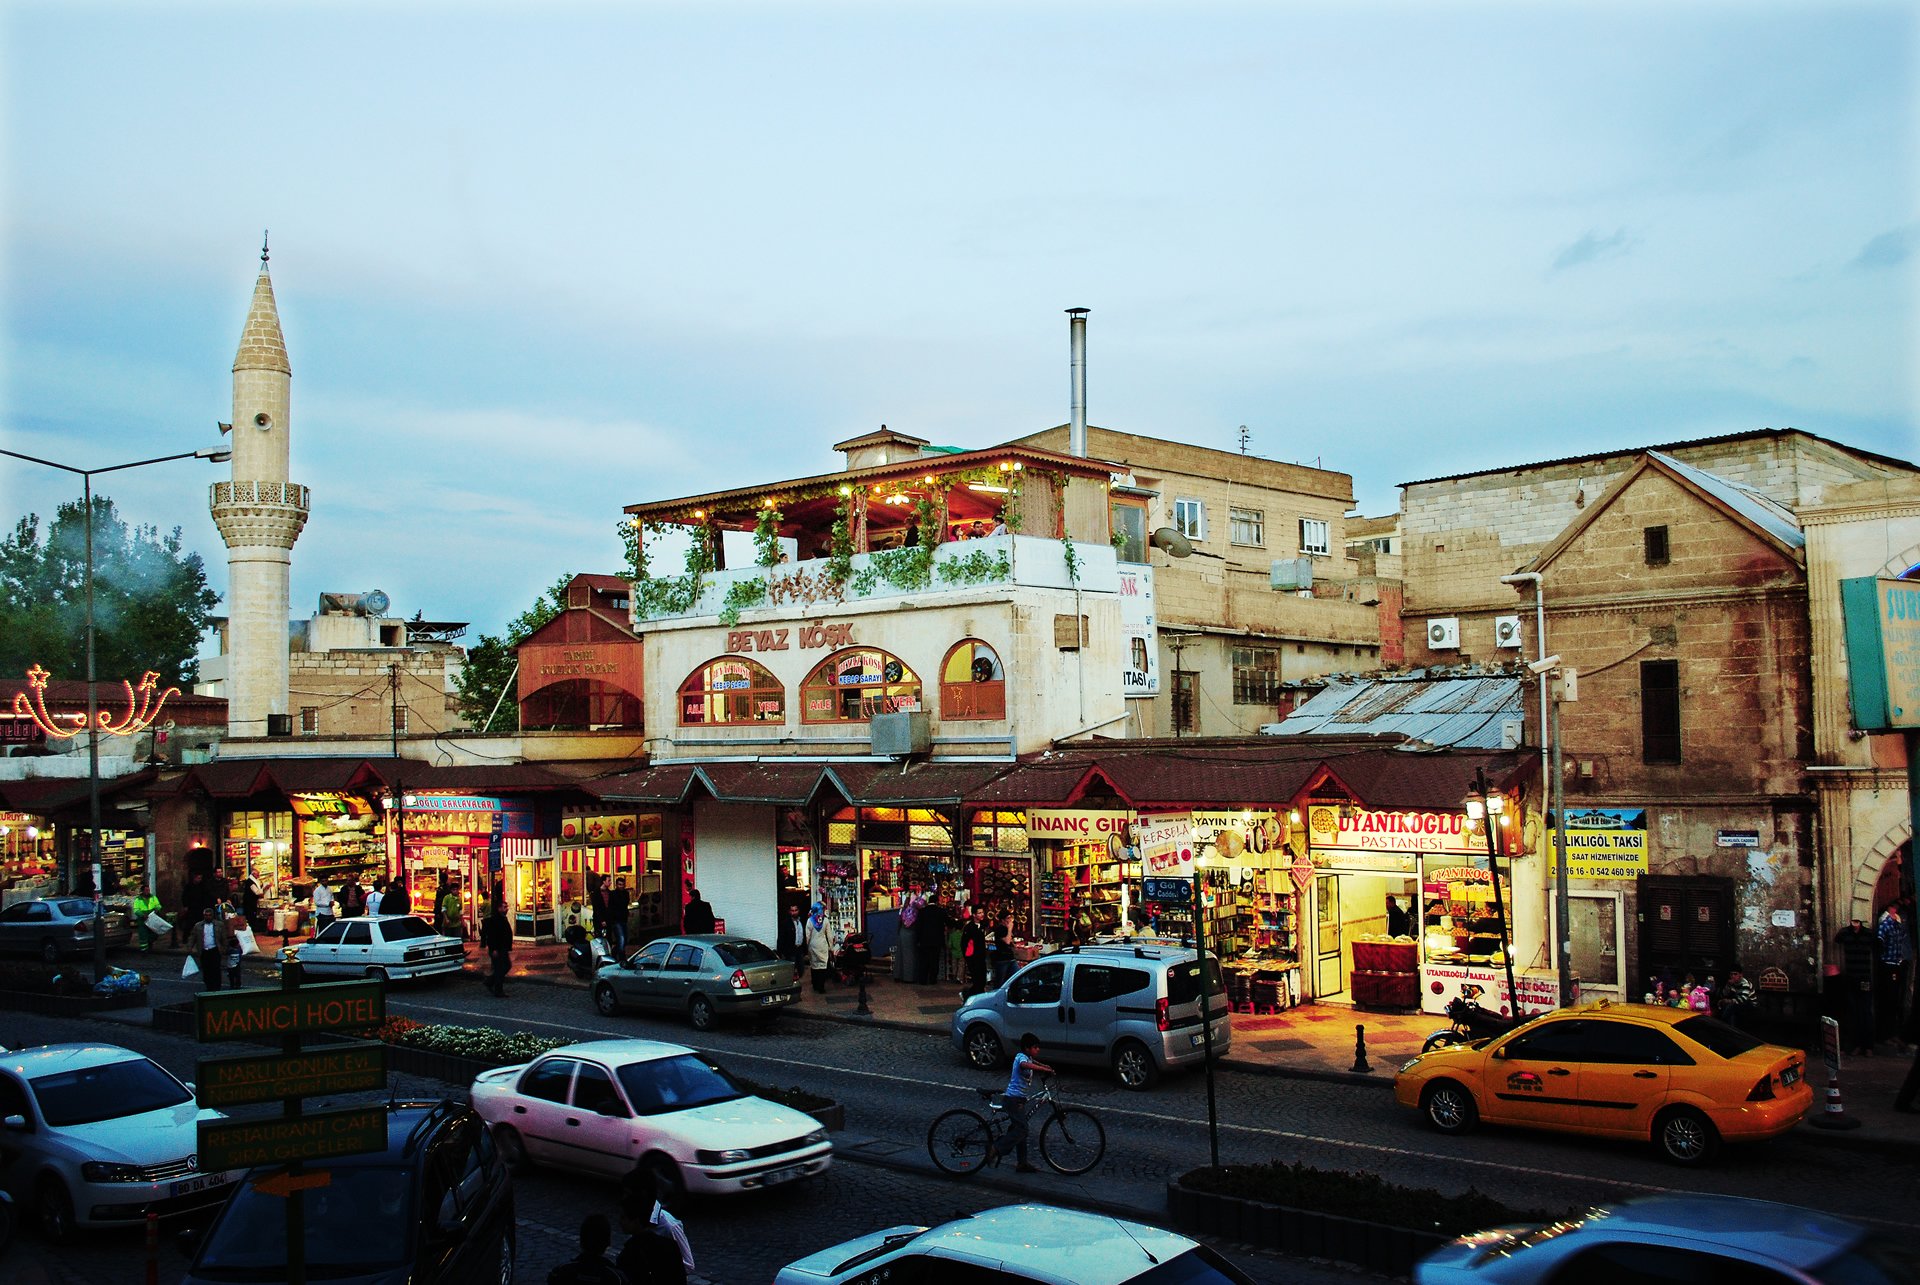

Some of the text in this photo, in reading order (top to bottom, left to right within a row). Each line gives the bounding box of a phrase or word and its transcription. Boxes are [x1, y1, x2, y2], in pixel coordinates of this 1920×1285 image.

[727, 620, 857, 653] BEYAZ KÖŞK
[584, 662, 618, 674] PAZARI
[712, 681, 730, 690] KEBAP
[839, 674, 882, 684] KEBAP SARAYI
[442, 800, 495, 809] BAKLAVALARI
[1032, 812, 1088, 835] İNANÇ
[1195, 818, 1226, 826] YAYIN
[1143, 824, 1189, 844] KERBELA
[1552, 834, 1642, 848] BLIKLIGÖL TAKSİ
[1590, 852, 1639, 862] HİZMETİNİZDE
[1577, 867, 1584, 875] 16
[1590, 868, 1594, 876] 0
[1596, 868, 1609, 876] 542
[1611, 868, 1624, 876] 460
[1626, 868, 1634, 876] 99
[1470, 972, 1496, 981] BAKLAV
[306, 996, 380, 1025] HOTEL
[276, 1056, 339, 1078] KONUK
[326, 1076, 376, 1090] House
[208, 1112, 382, 1148] RESTAURANT CAFE
[194, 1180, 206, 1190] DA
[209, 1174, 225, 1186] 404
